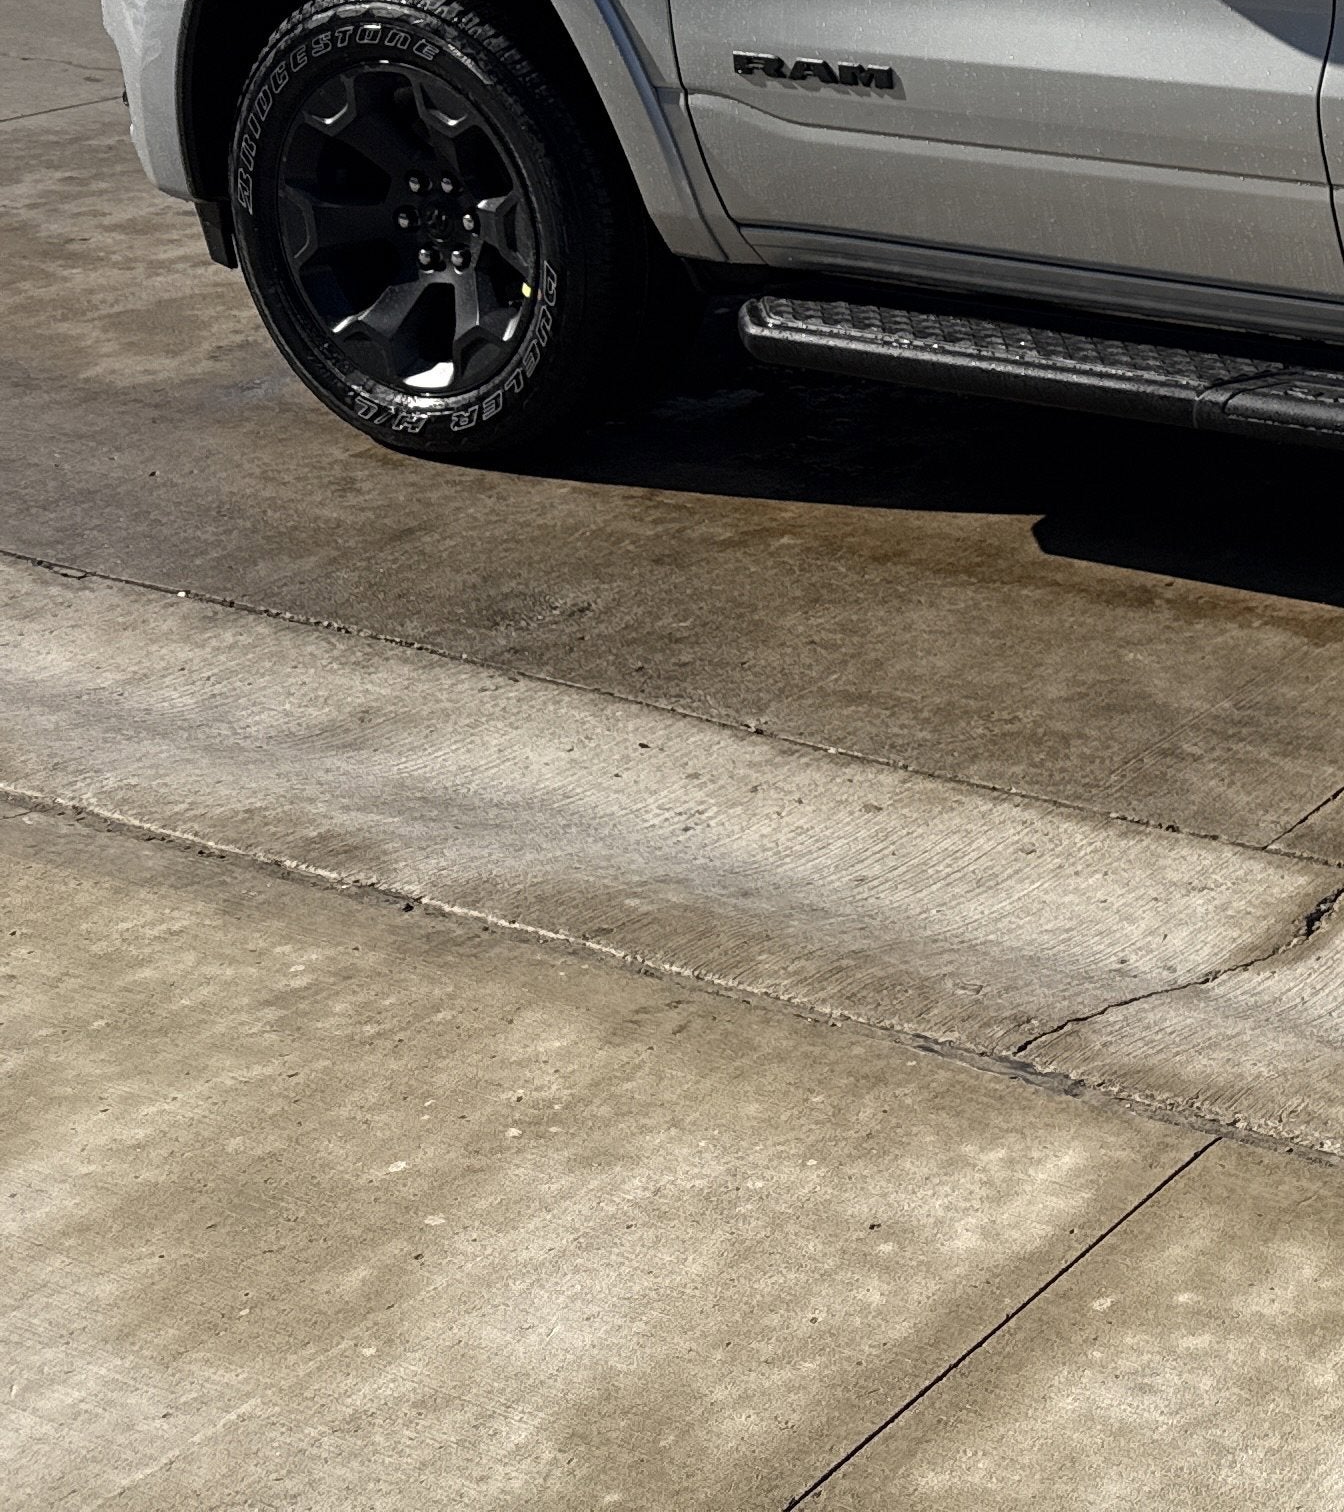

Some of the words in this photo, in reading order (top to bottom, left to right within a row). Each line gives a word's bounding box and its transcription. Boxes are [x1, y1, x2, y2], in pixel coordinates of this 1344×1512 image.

[236, 25, 440, 215] BRIDGESTONE
[732, 50, 894, 89] RAM
[449, 260, 557, 432] DUELER
